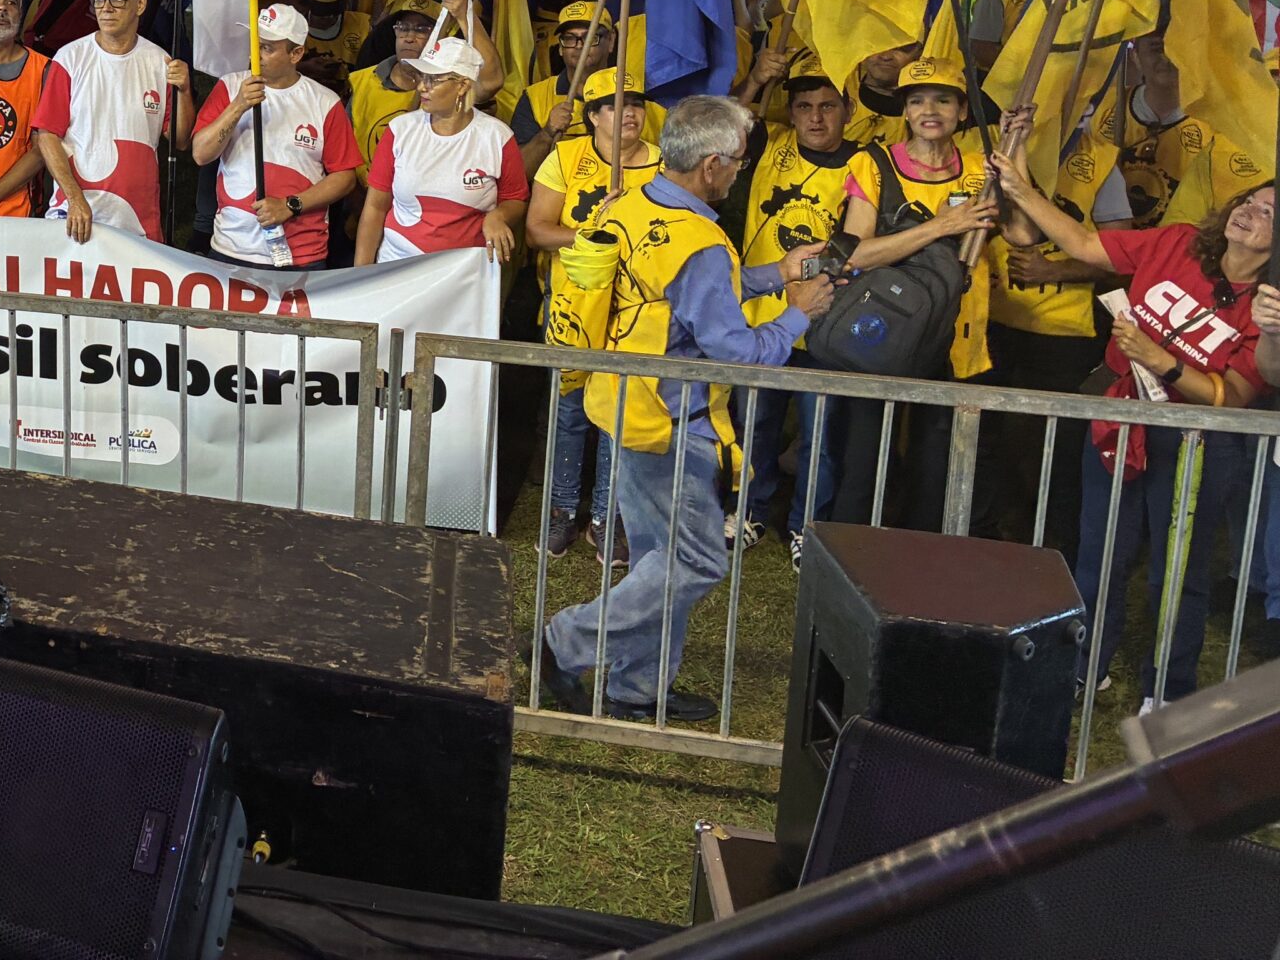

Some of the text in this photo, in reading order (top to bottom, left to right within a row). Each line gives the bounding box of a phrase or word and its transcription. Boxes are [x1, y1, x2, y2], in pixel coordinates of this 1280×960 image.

[294, 134, 317, 146] UGT
[1134, 304, 1163, 333] SANTA
[1144, 280, 1238, 354] CUT
[80, 324, 448, 414] soberano
